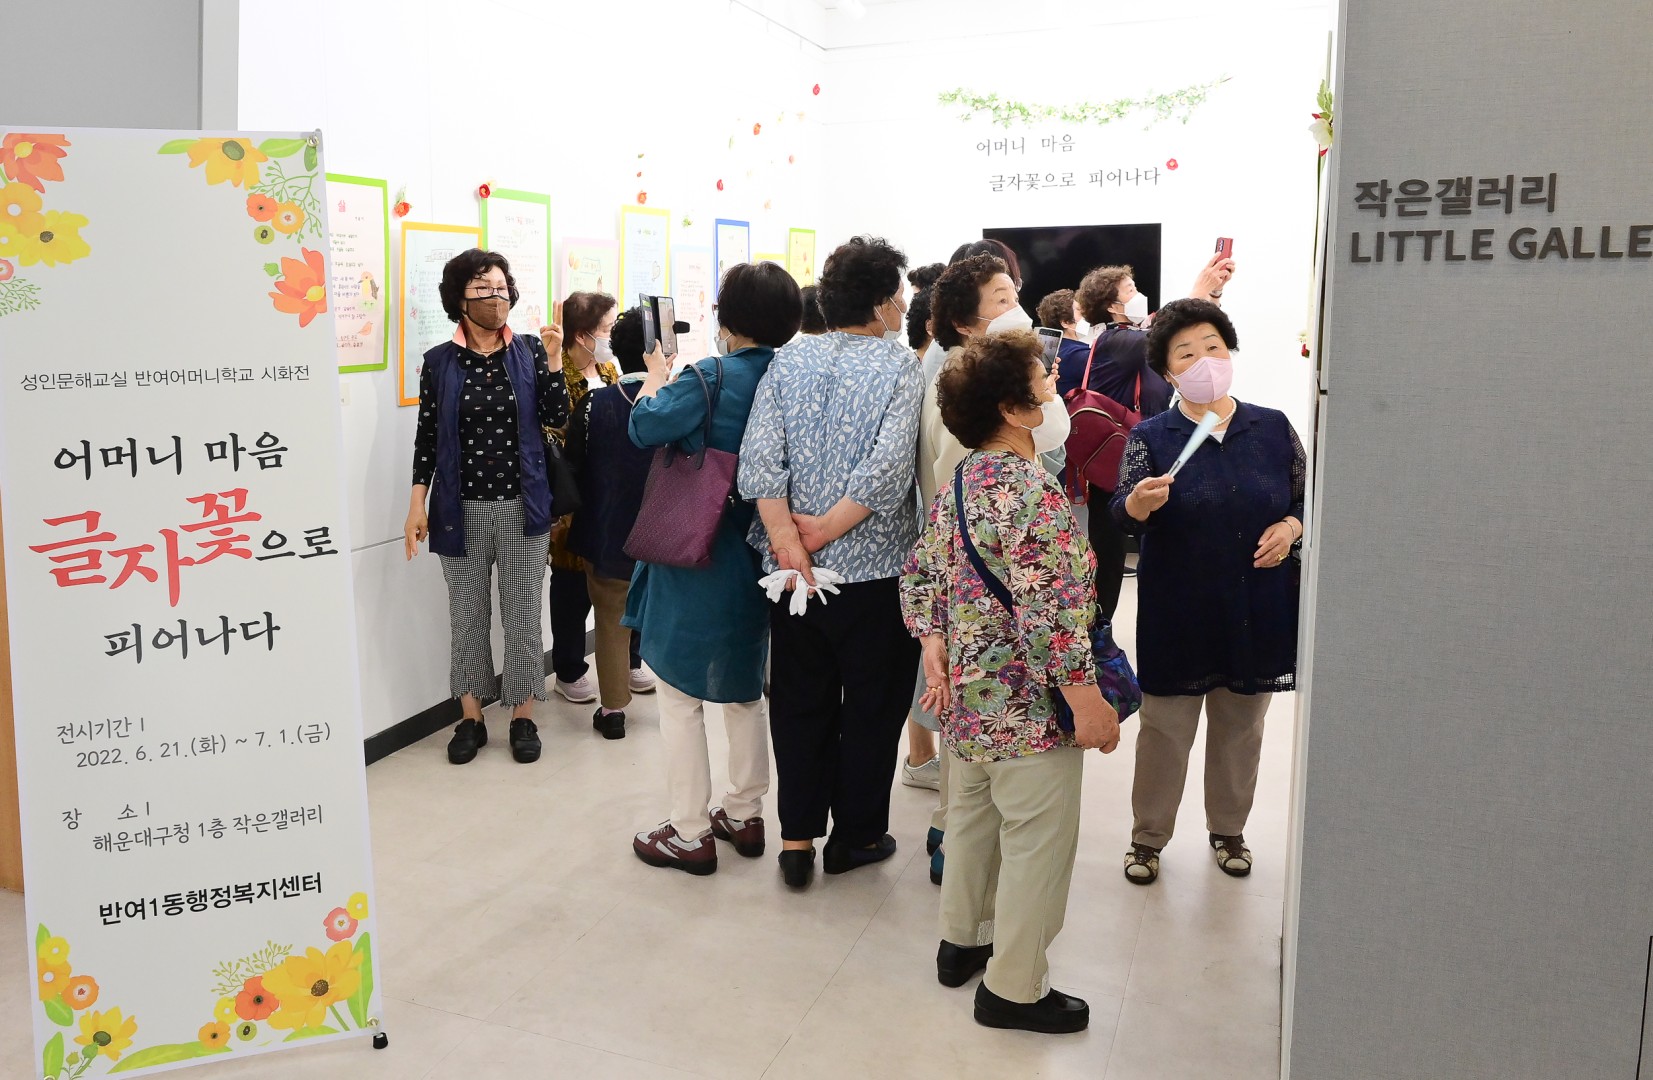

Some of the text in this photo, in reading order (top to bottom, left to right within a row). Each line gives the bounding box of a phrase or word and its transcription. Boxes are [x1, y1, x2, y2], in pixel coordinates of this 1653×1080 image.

[976, 134, 1074, 156] 어머니 마음
[989, 167, 1160, 192] 글자꽃으로 피어나다
[1355, 173, 1556, 217] 작은갤러리
[1351, 225, 1653, 262] LITTLE GALLE
[21, 365, 309, 391] 성인문해교실 반여어머니학교 시화전
[54, 432, 288, 480] 어머니 마음
[28, 488, 338, 608] 글자꽃으로
[104, 611, 281, 664] 피어나다
[57, 717, 132, 744] 전시기간
[77, 749, 128, 767] 2022.
[62, 804, 138, 830] 장 소
[93, 805, 322, 853] 해운대구청 1층 작은갤러리
[99, 872, 322, 926] 반여1동행정복지센터
